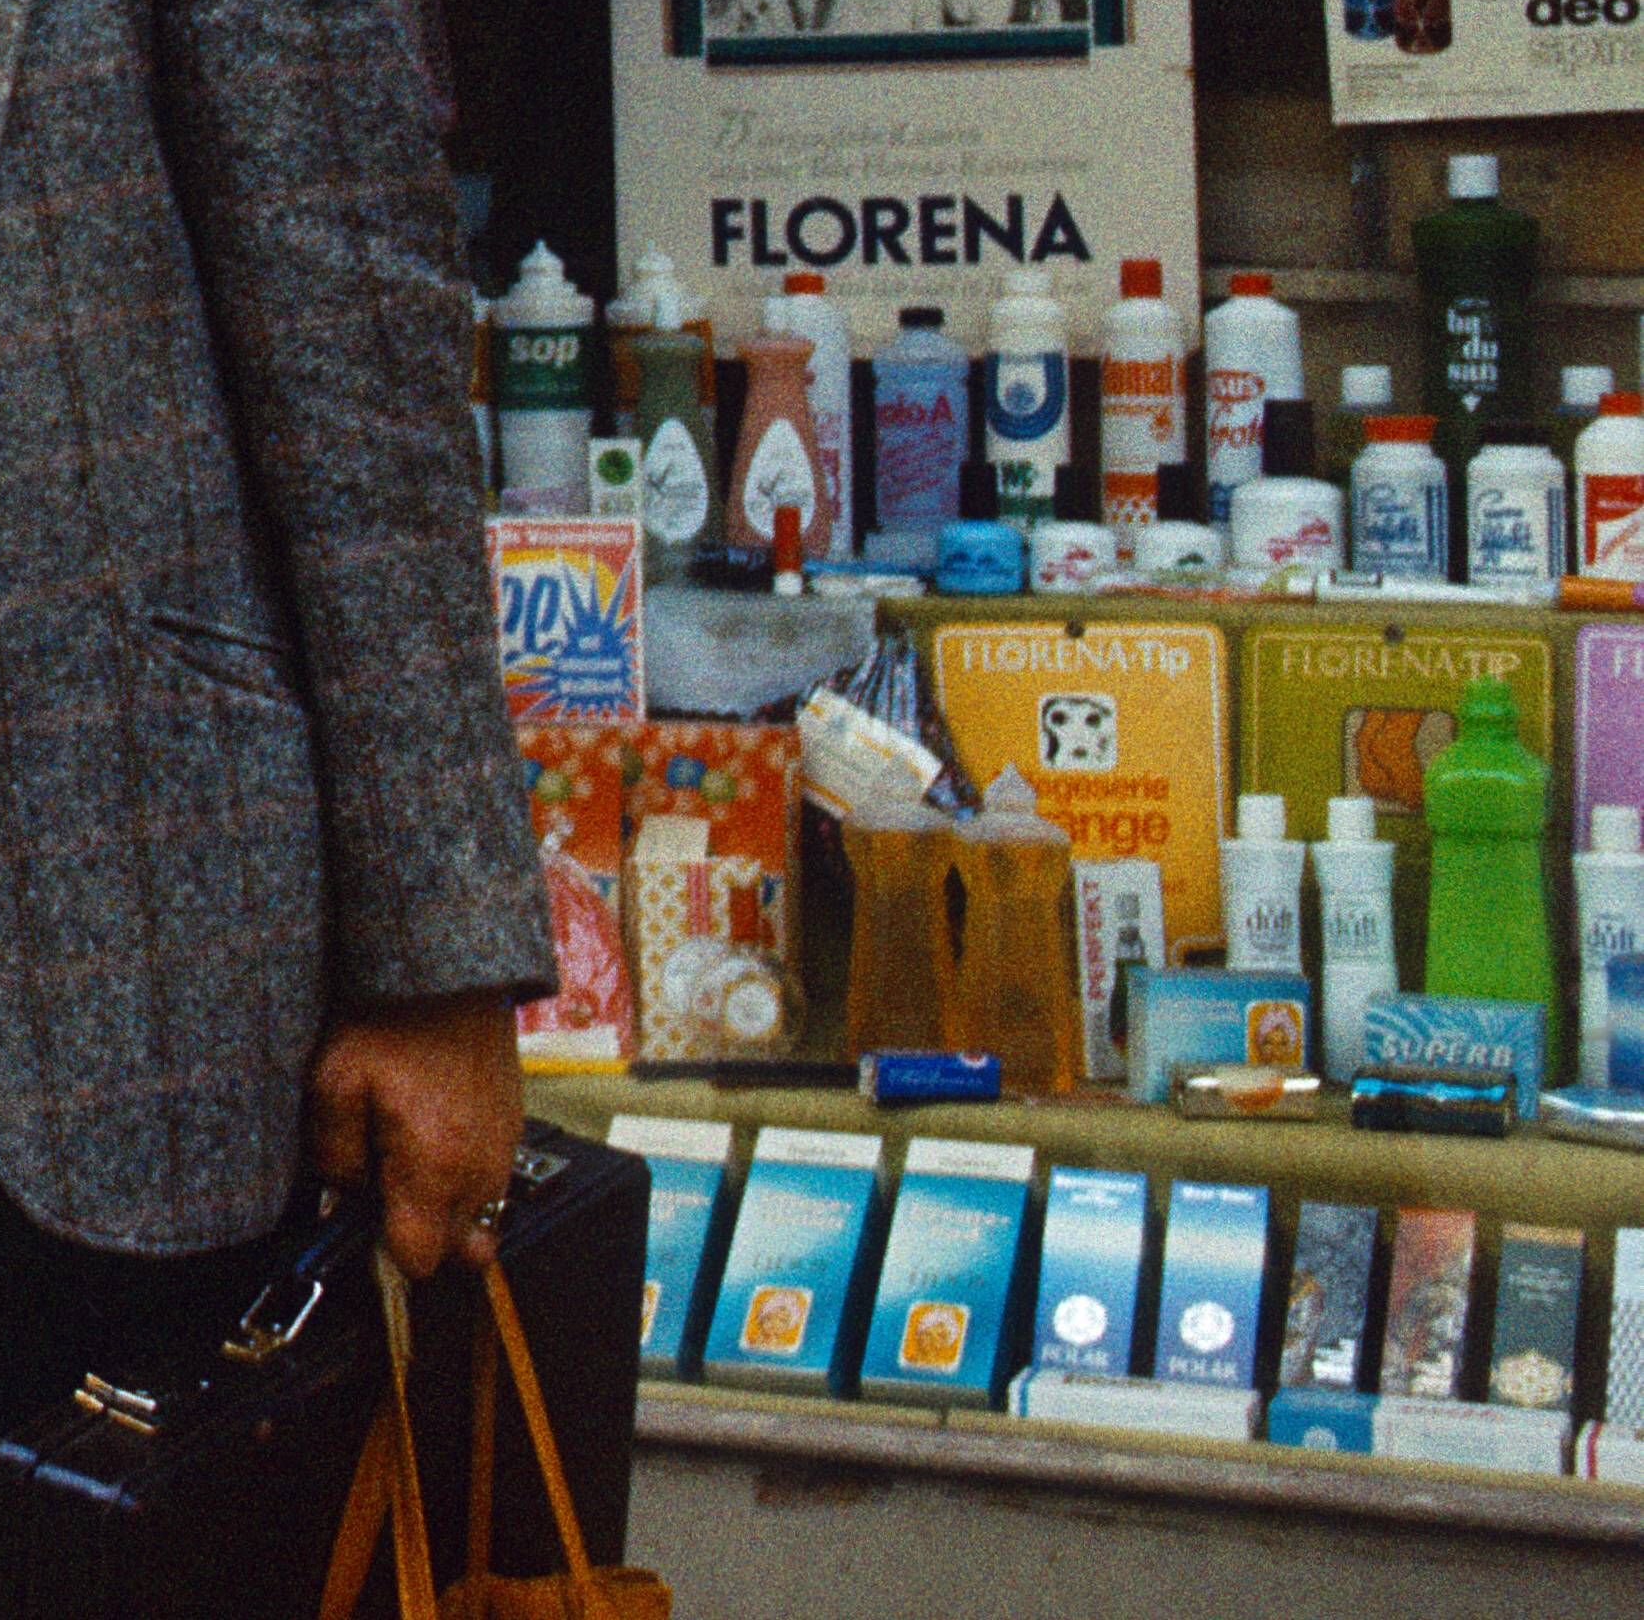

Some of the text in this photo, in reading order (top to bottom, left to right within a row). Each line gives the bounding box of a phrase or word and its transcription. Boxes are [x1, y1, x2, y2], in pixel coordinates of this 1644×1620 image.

[710, 190, 1093, 267] FLORENA
[508, 333, 581, 371] sop
[1379, 1034, 1514, 1070] SUPERB
